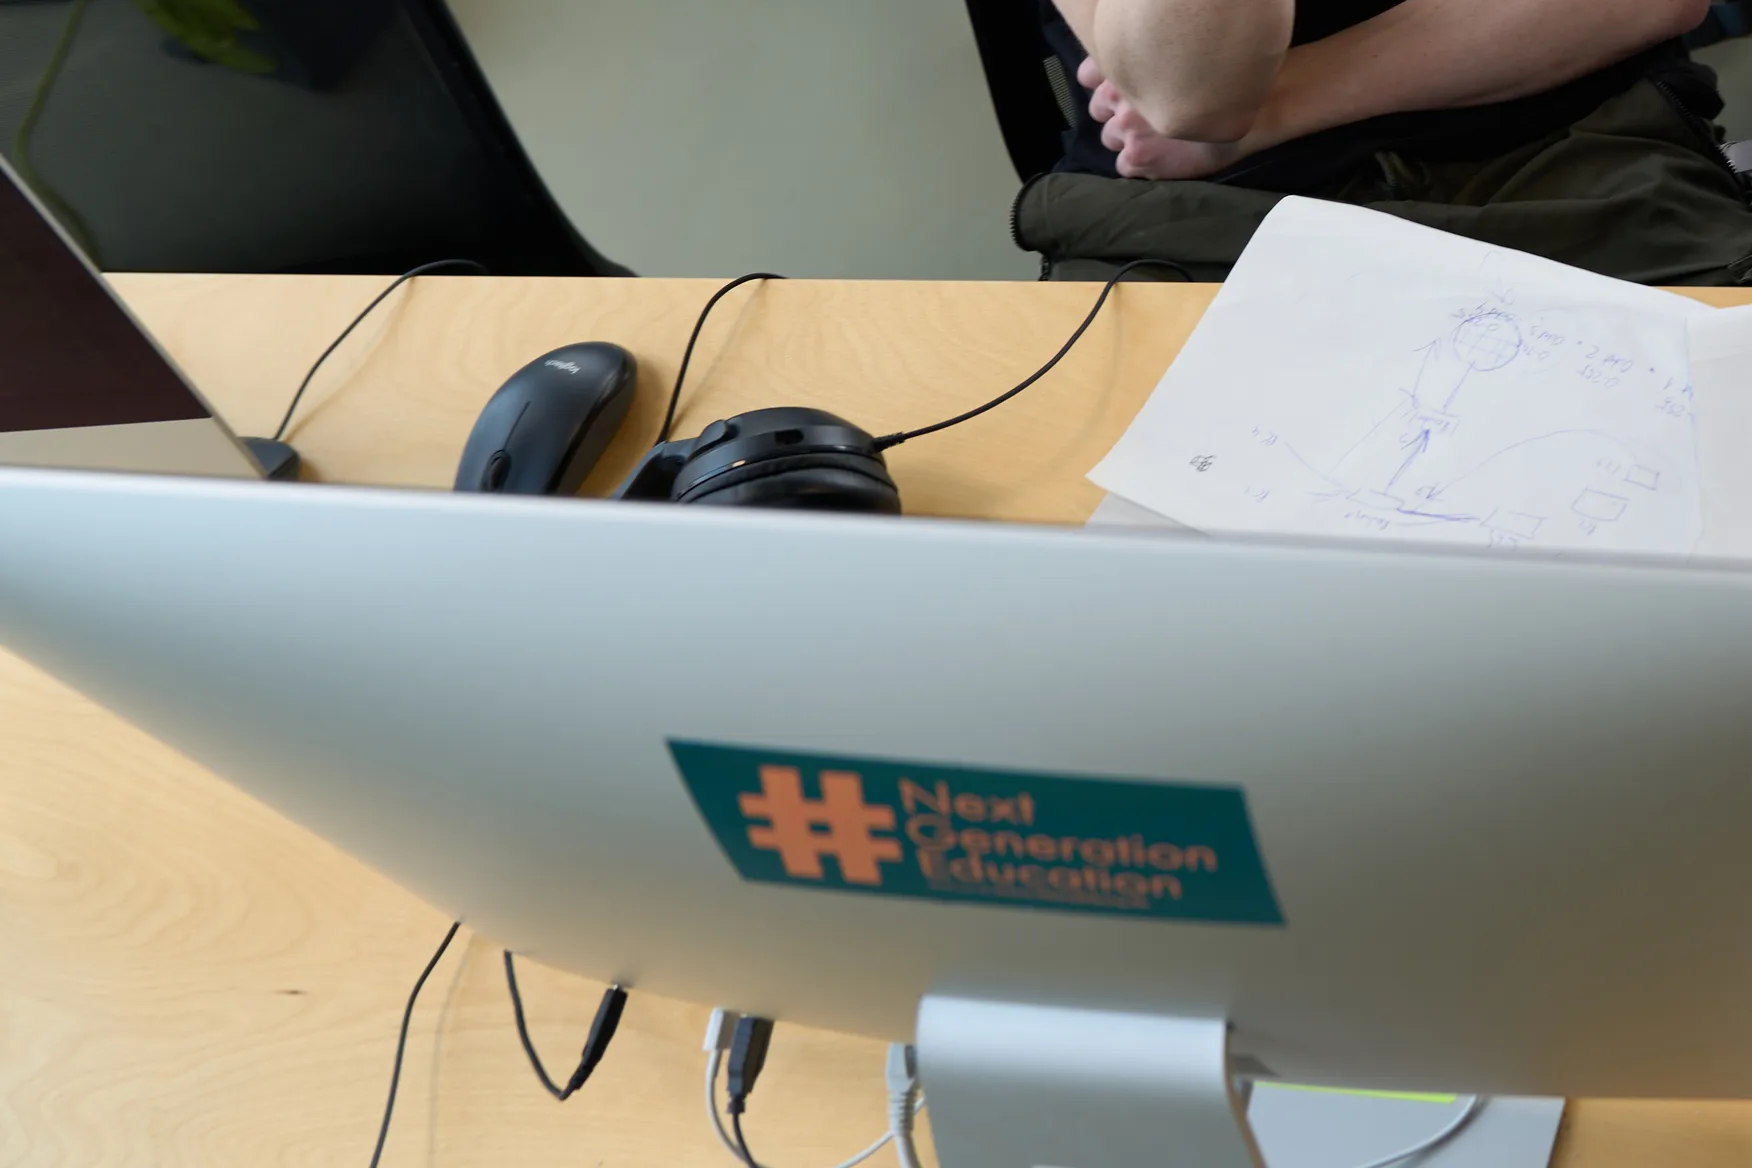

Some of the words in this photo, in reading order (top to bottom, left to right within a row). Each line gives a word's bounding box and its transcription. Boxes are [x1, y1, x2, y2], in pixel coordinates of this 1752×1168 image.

[898, 776, 1036, 826] Next
[904, 810, 1219, 874] Generation
[915, 845, 1184, 902] Education
